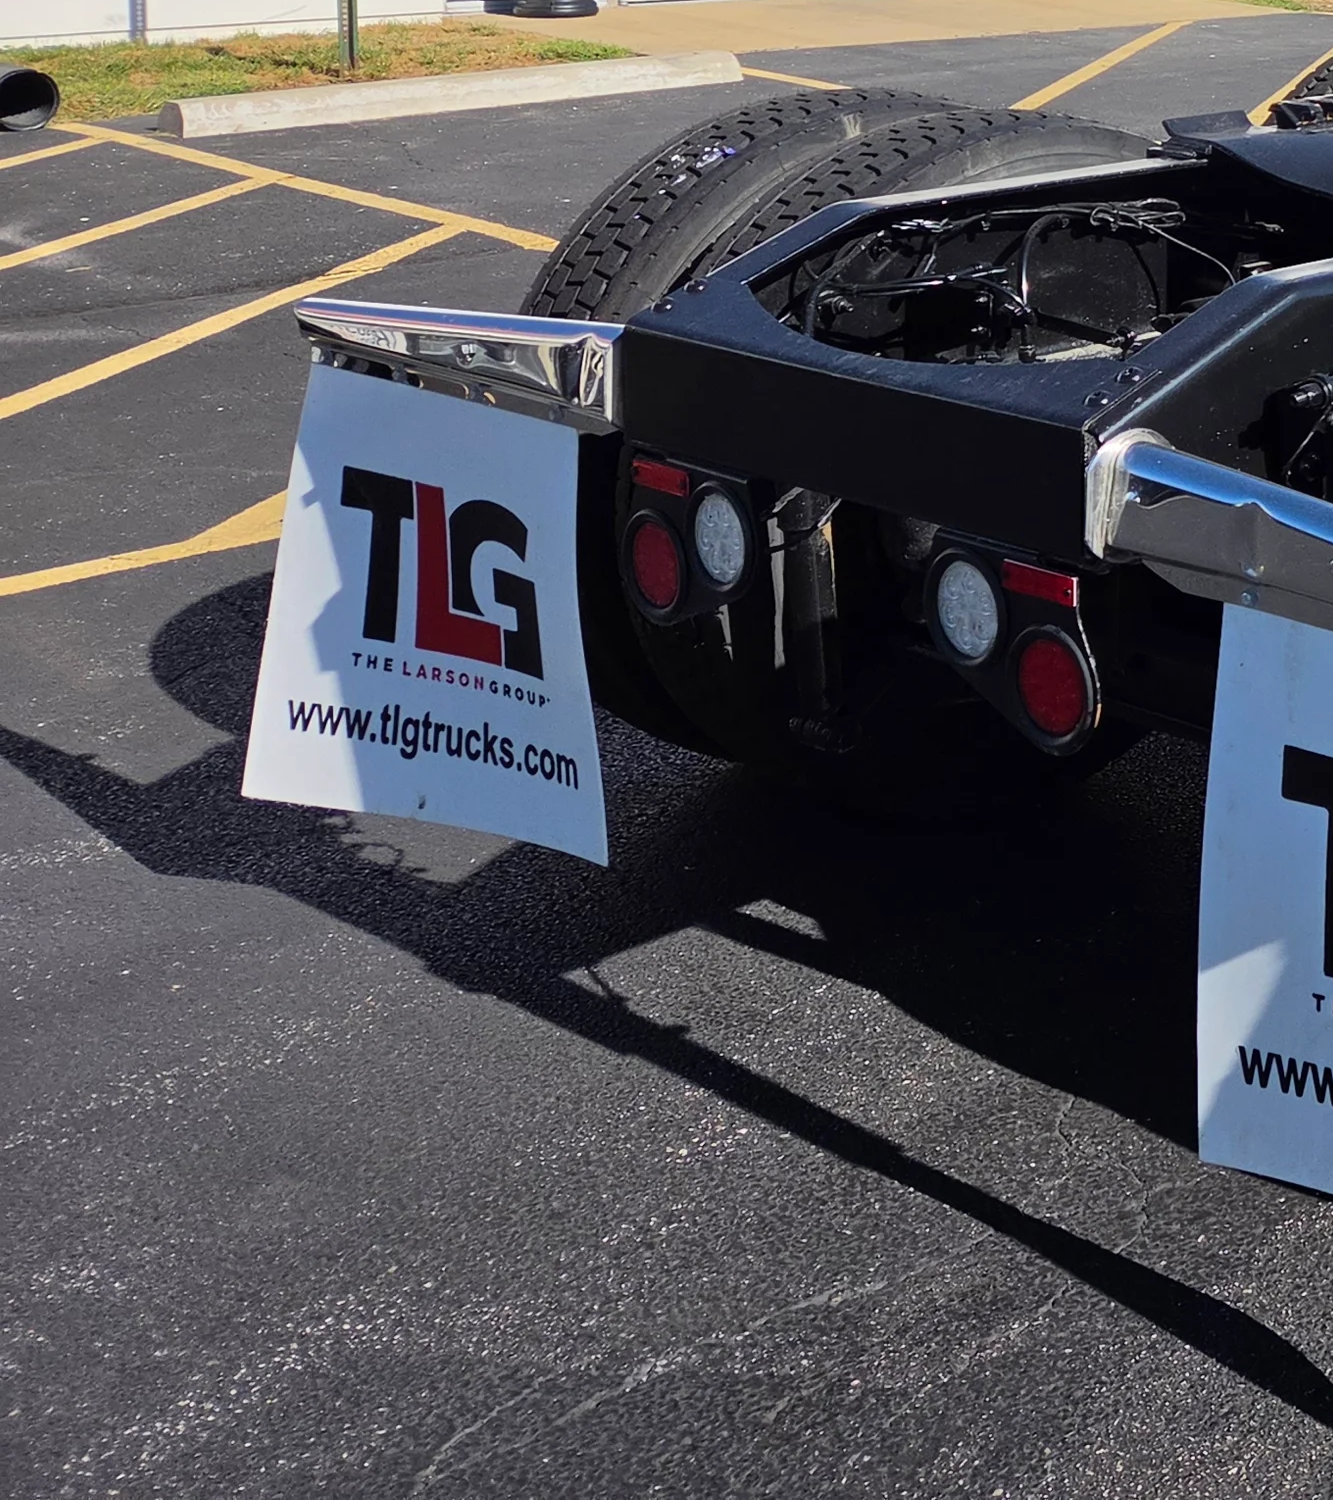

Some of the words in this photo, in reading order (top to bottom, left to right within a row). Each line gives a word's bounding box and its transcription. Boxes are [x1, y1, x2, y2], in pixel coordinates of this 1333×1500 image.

[341, 465, 545, 681] TLG
[352, 651, 394, 673] THE
[401, 660, 485, 692] LARSON
[489, 680, 549, 708] GROUP
[288, 698, 579, 791] www.tlgtrucks.com
